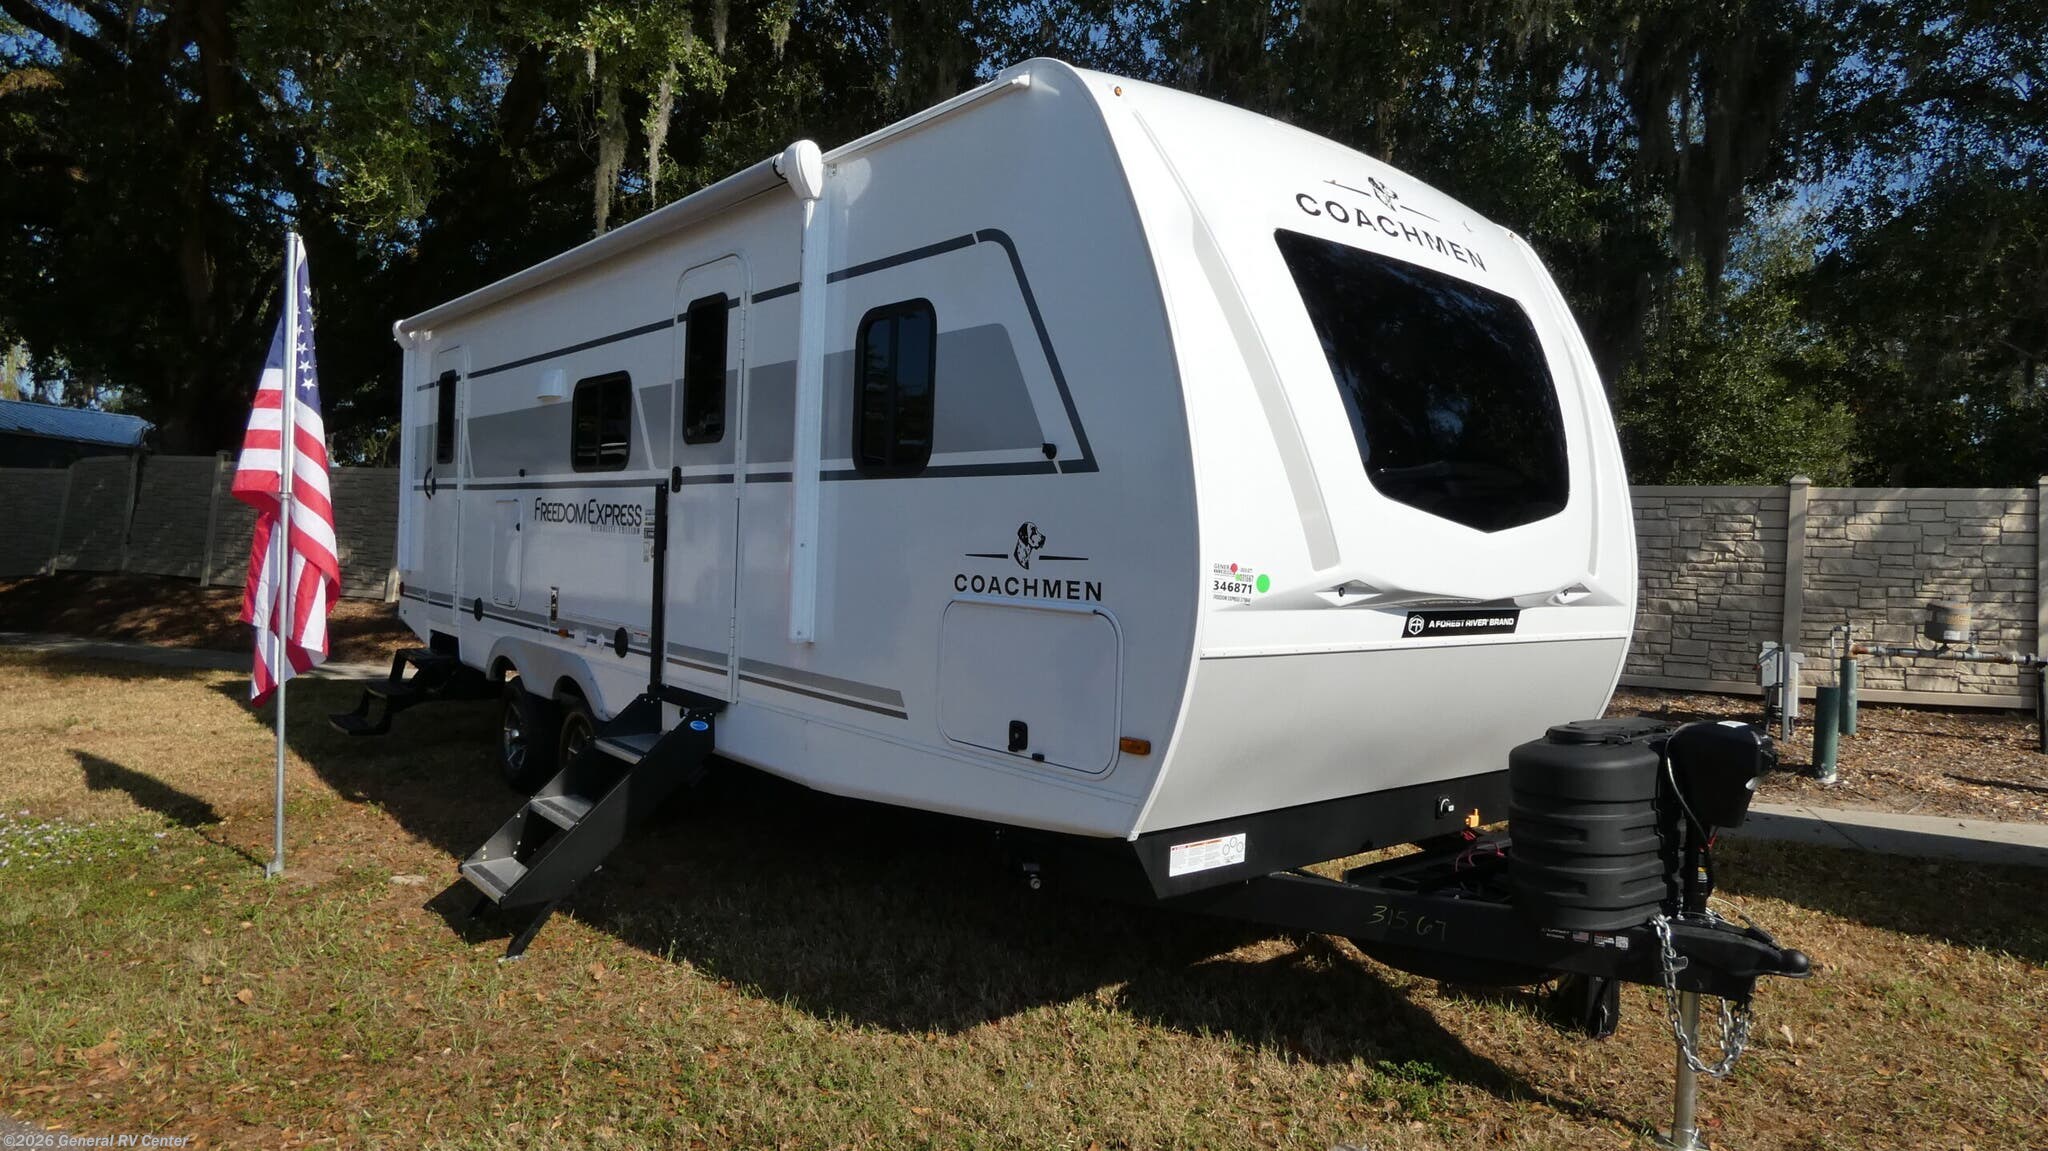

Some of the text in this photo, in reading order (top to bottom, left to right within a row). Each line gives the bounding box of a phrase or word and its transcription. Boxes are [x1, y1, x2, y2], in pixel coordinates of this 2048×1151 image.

[1295, 193, 1487, 272] COACHMEN
[954, 573, 1102, 602] COACHMEN
[1213, 580, 1253, 594] 346871
[1428, 617, 1514, 628] A FOREST RIVER BRAND
